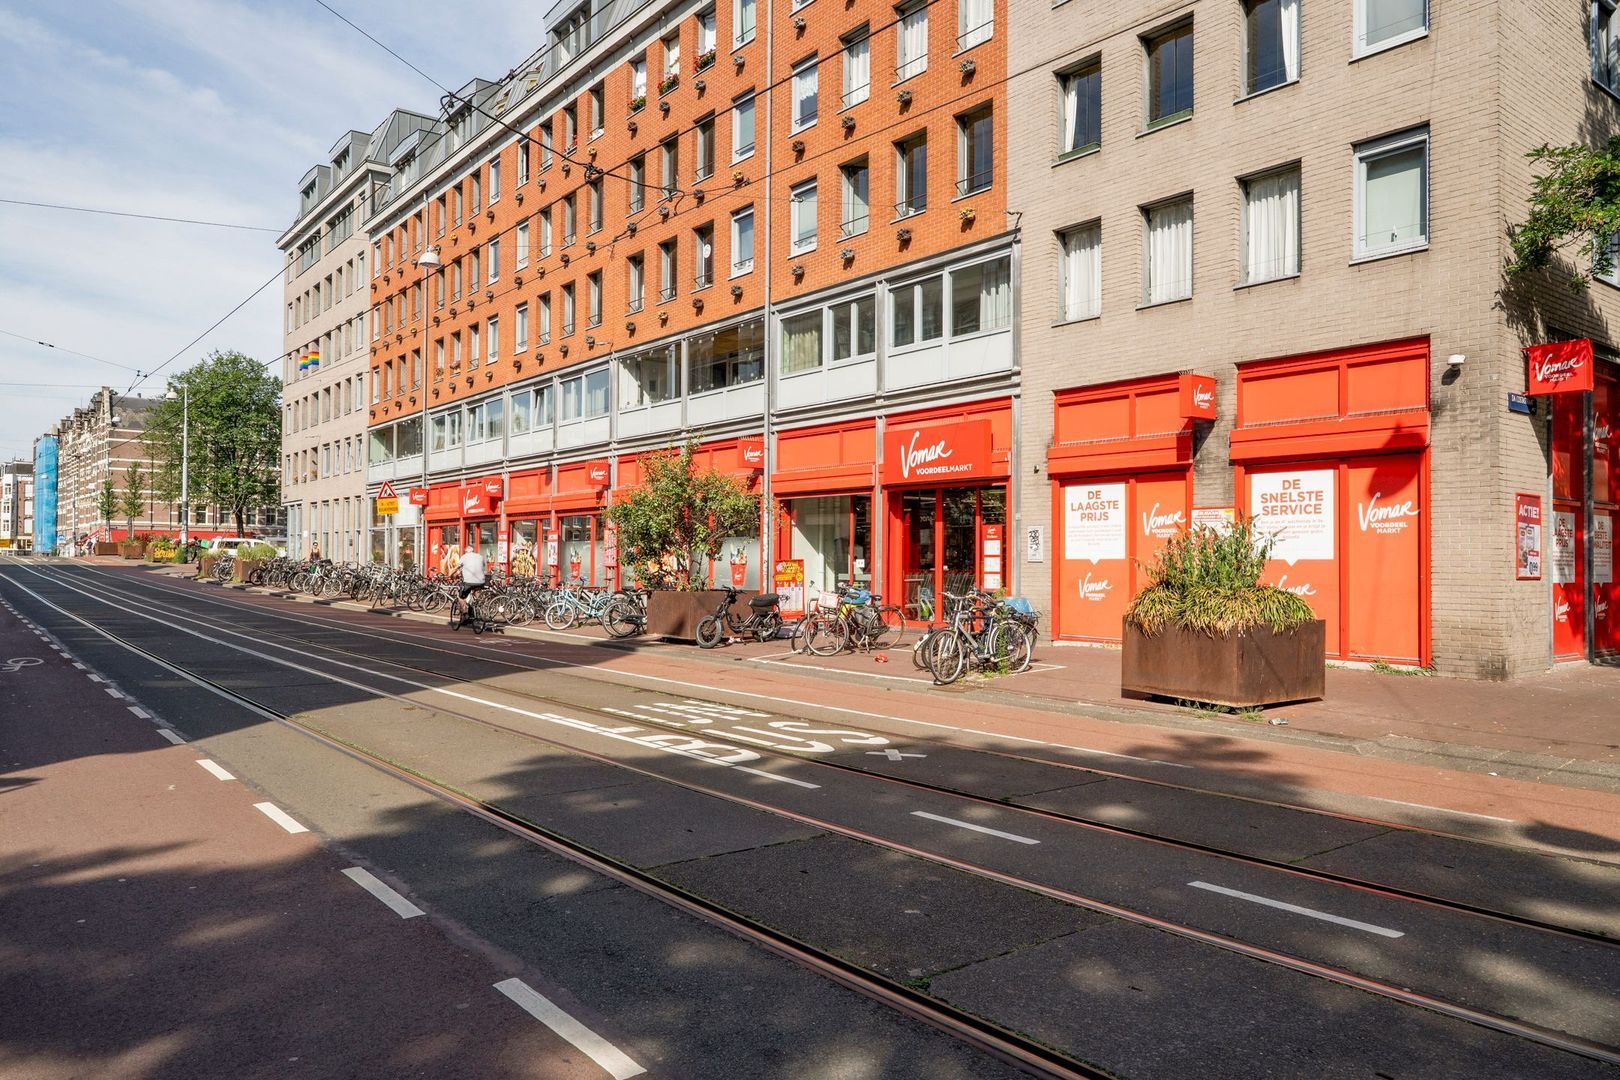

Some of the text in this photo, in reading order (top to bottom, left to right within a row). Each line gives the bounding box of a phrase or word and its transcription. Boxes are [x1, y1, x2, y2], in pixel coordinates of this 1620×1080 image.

[1535, 353, 1584, 382] Vomar
[1193, 384, 1214, 406] Vomar
[743, 446, 764, 461] Vomar
[901, 431, 953, 479] Vomar
[916, 464, 972, 475] VOORDEELMARKT
[1282, 479, 1301, 490] DE
[1087, 490, 1102, 500] DE
[1260, 490, 1324, 504] SNELSTE
[1070, 500, 1119, 511] LAAGSTE
[1262, 503, 1322, 516] SERVICE
[1358, 491, 1420, 531] Vomar
[1080, 511, 1109, 522] PRIJS
[1142, 502, 1187, 536] Vomar
[1079, 571, 1113, 599] Vomar
